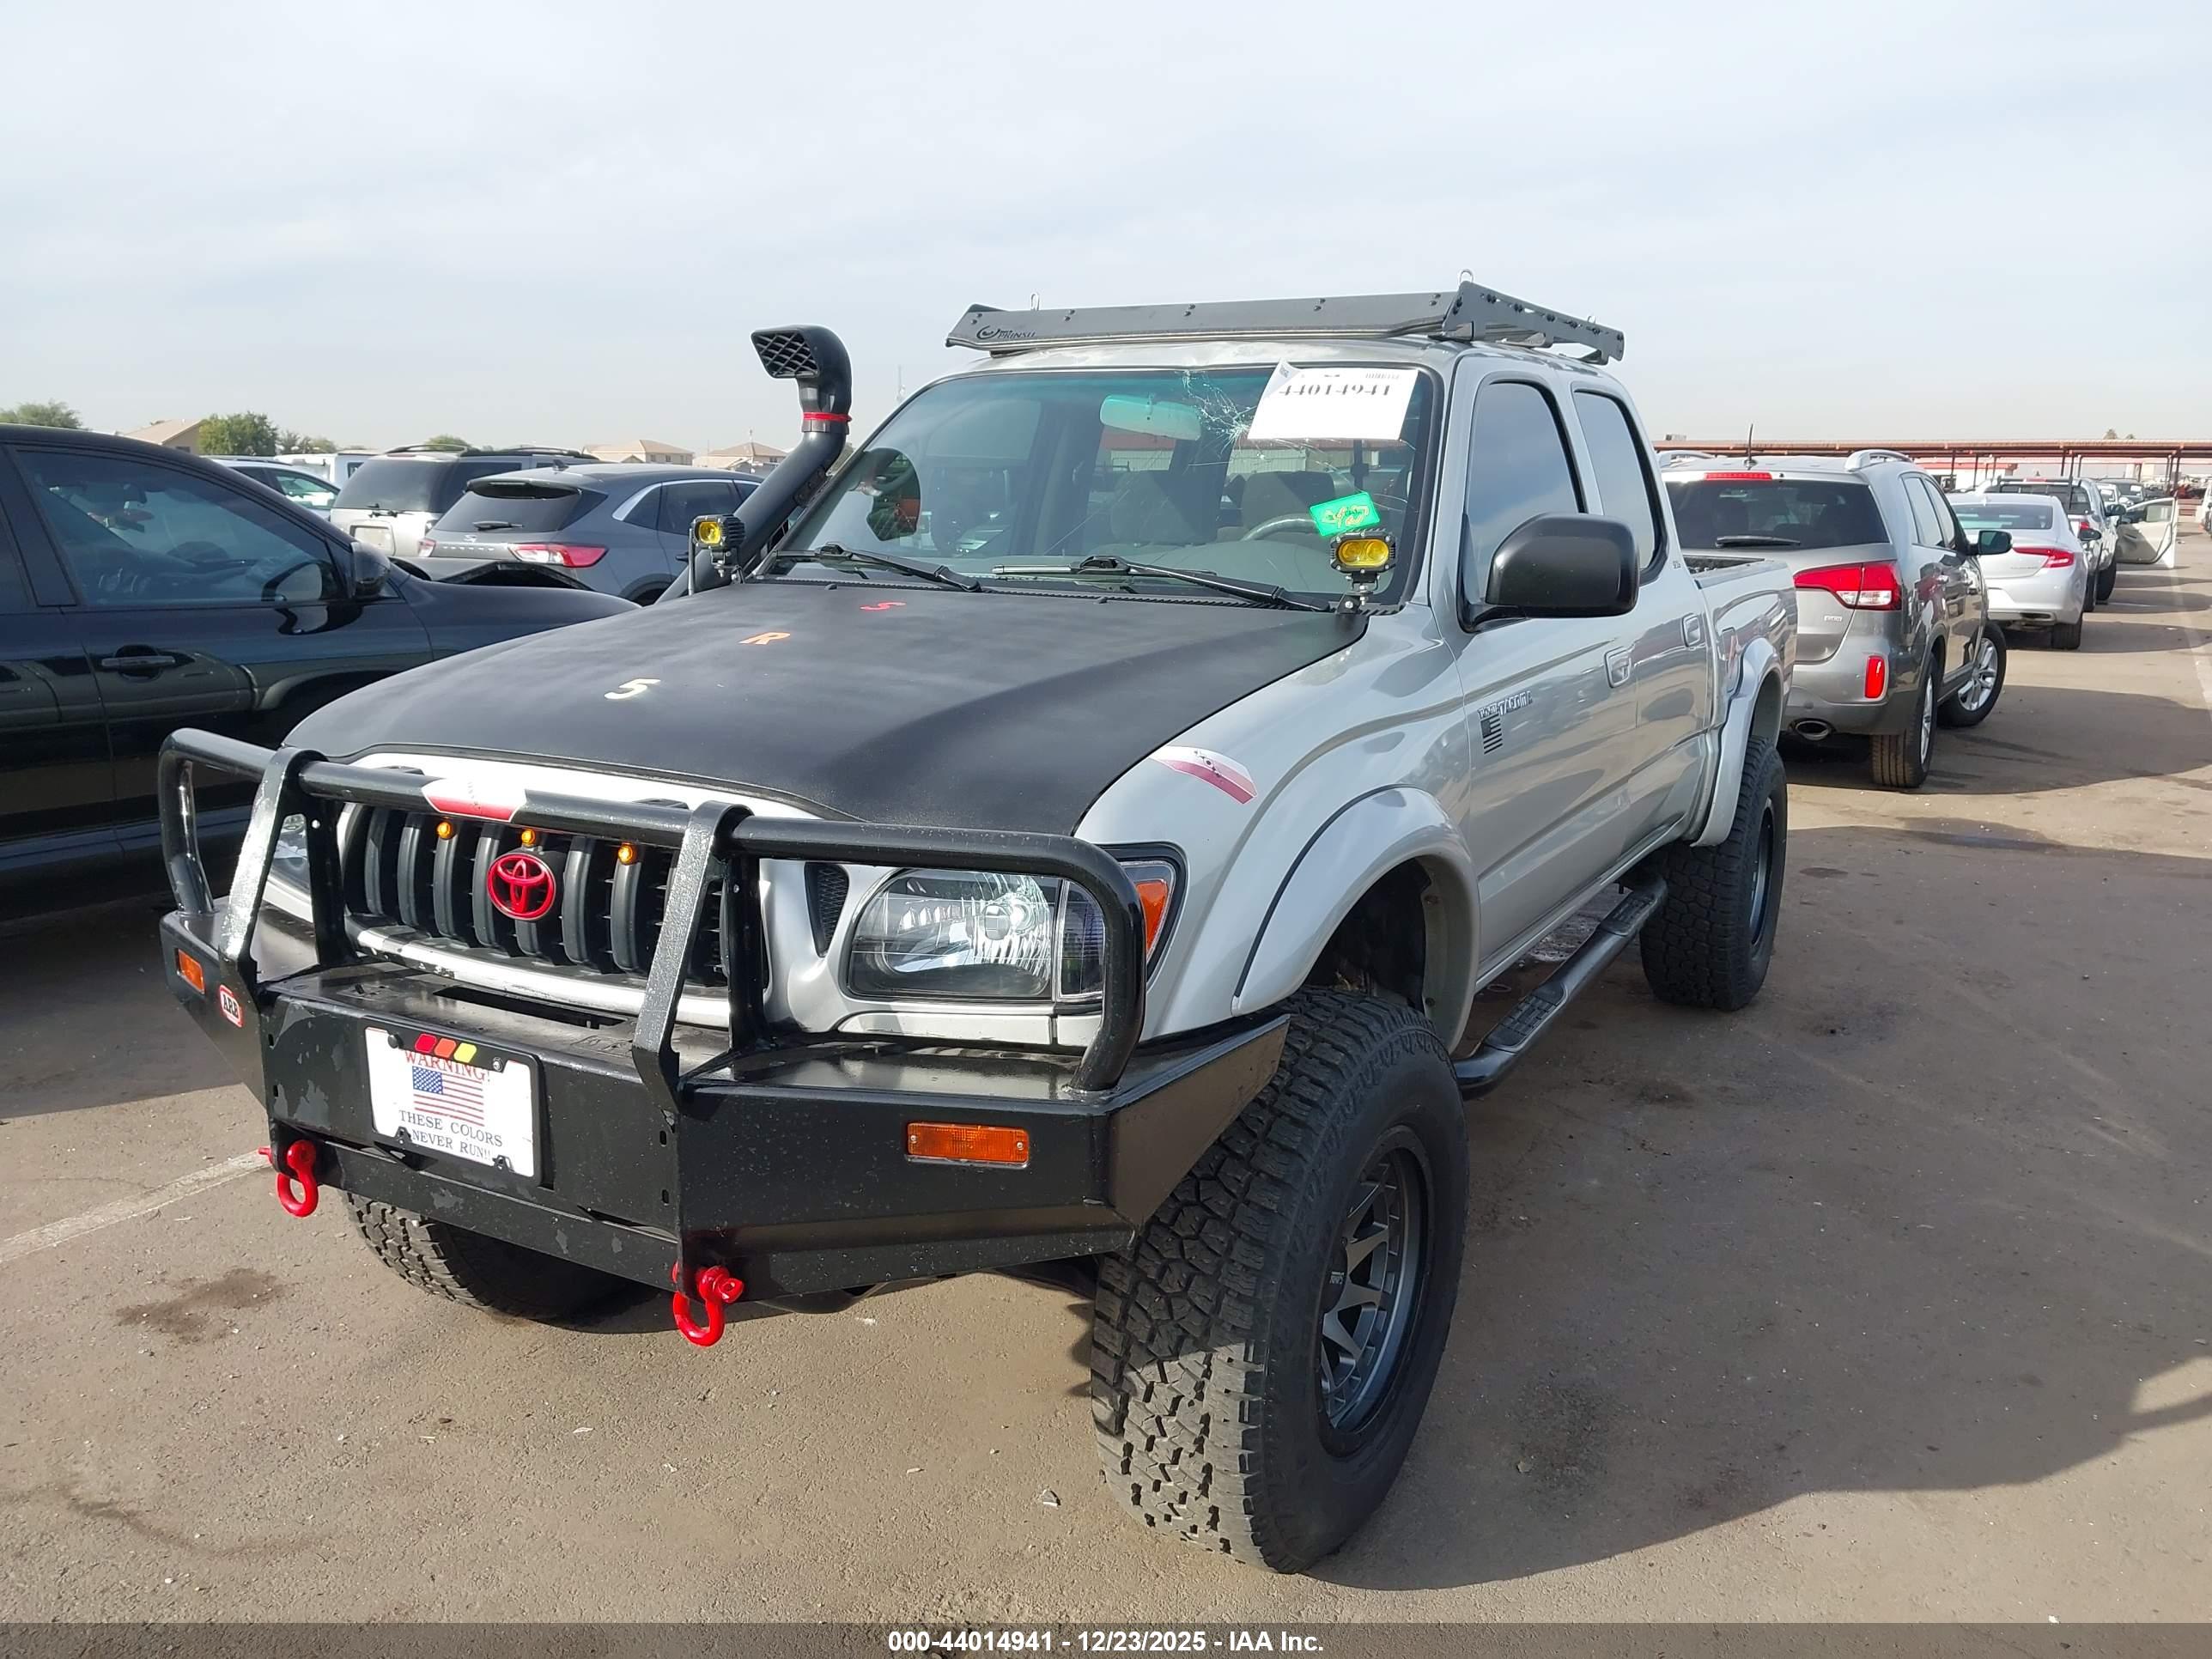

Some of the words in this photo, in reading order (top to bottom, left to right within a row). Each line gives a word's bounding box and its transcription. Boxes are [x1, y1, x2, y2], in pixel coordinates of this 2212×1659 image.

[1279, 384, 1390, 397] 44014941
[404, 1050, 491, 1083] WARNING!
[398, 1109, 443, 1131] THESE
[450, 1121, 503, 1148] COLORS
[412, 1128, 454, 1151] NEVER
[459, 1141, 491, 1160] RUN!!
